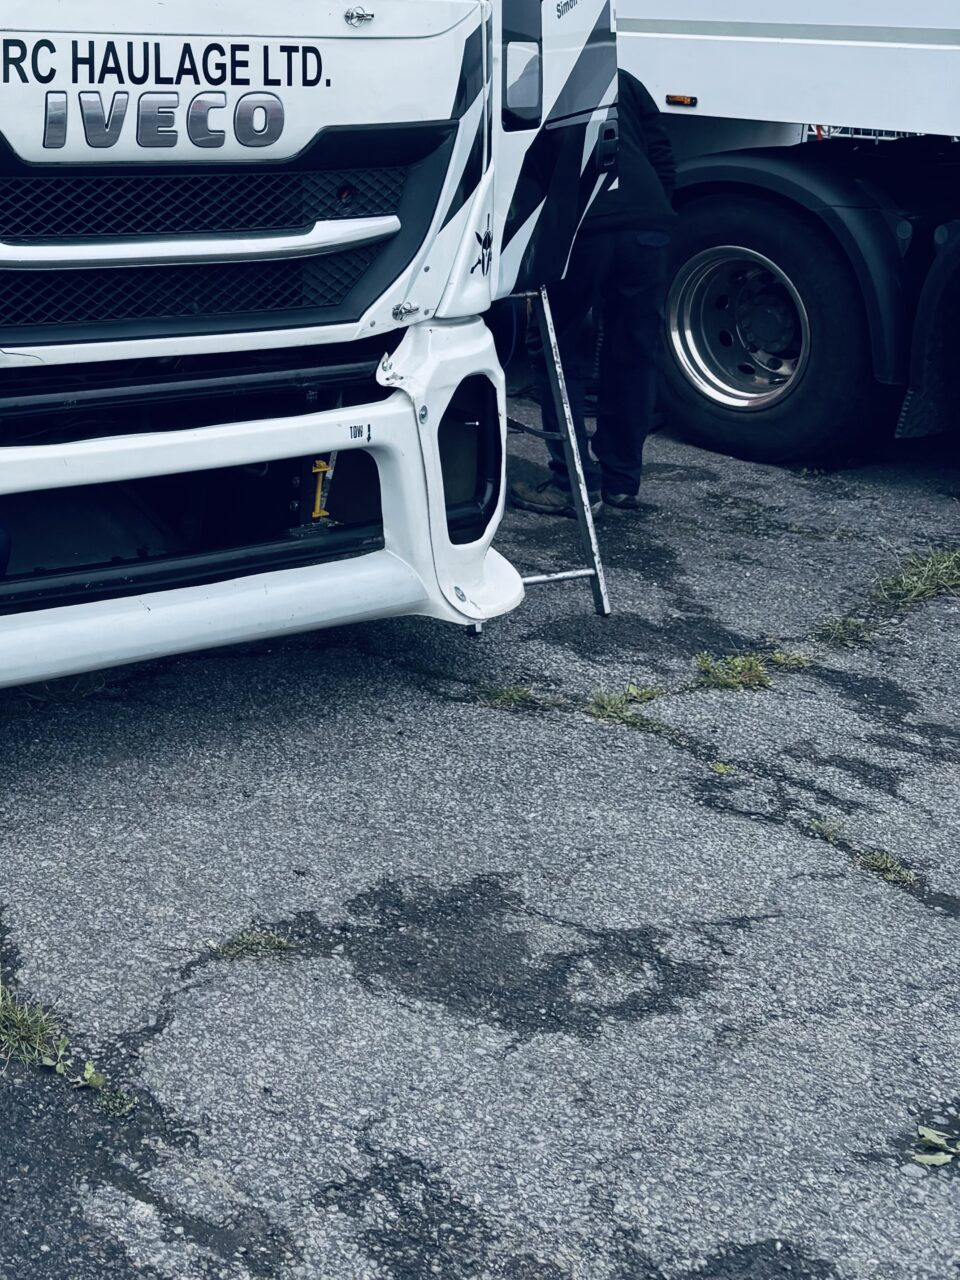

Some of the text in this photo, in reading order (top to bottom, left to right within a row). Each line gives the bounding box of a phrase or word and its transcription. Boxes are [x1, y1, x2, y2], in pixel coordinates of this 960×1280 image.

[2, 38, 331, 88] RC HAULAGE LTD.
[42, 89, 286, 150] IVECO
[349, 425, 364, 439] TOW
